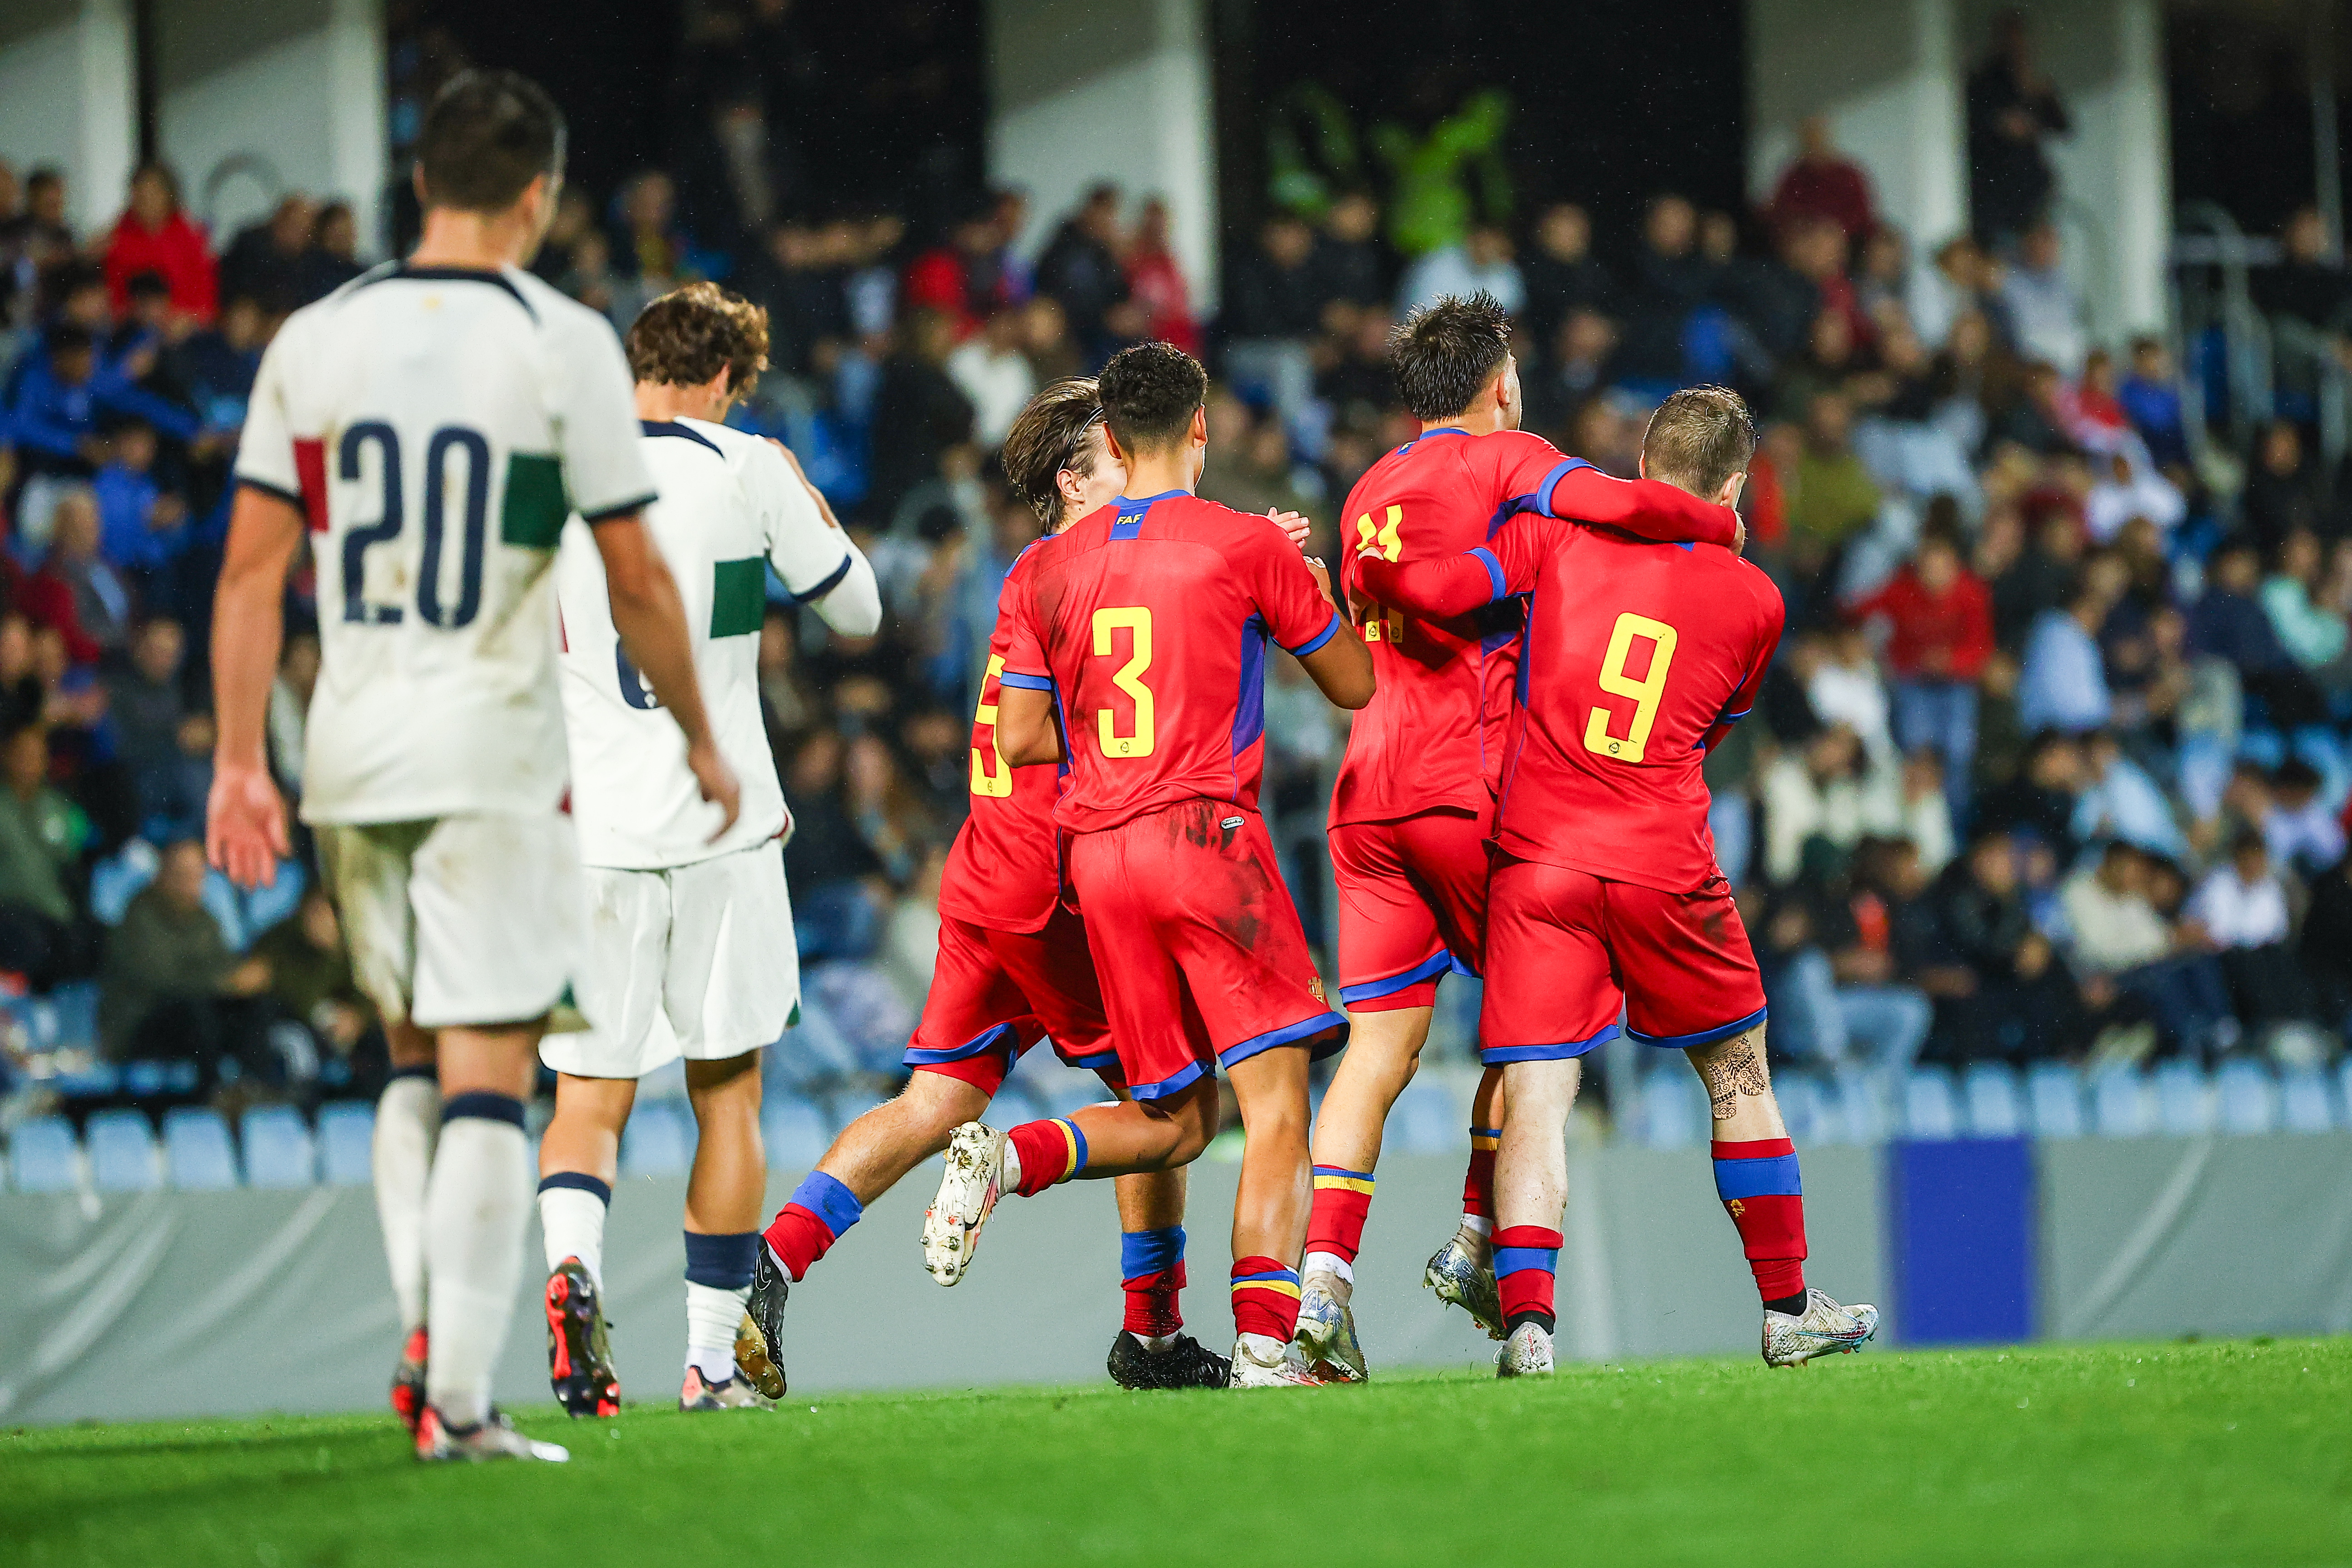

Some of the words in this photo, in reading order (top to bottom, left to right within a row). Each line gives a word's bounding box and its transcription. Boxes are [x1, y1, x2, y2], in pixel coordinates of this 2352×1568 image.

[340, 423, 489, 627] 20
[1116, 513, 1144, 525] FAF
[970, 653, 1013, 798] 5
[1092, 606, 1154, 758] 3
[1584, 612, 1678, 763] 9
